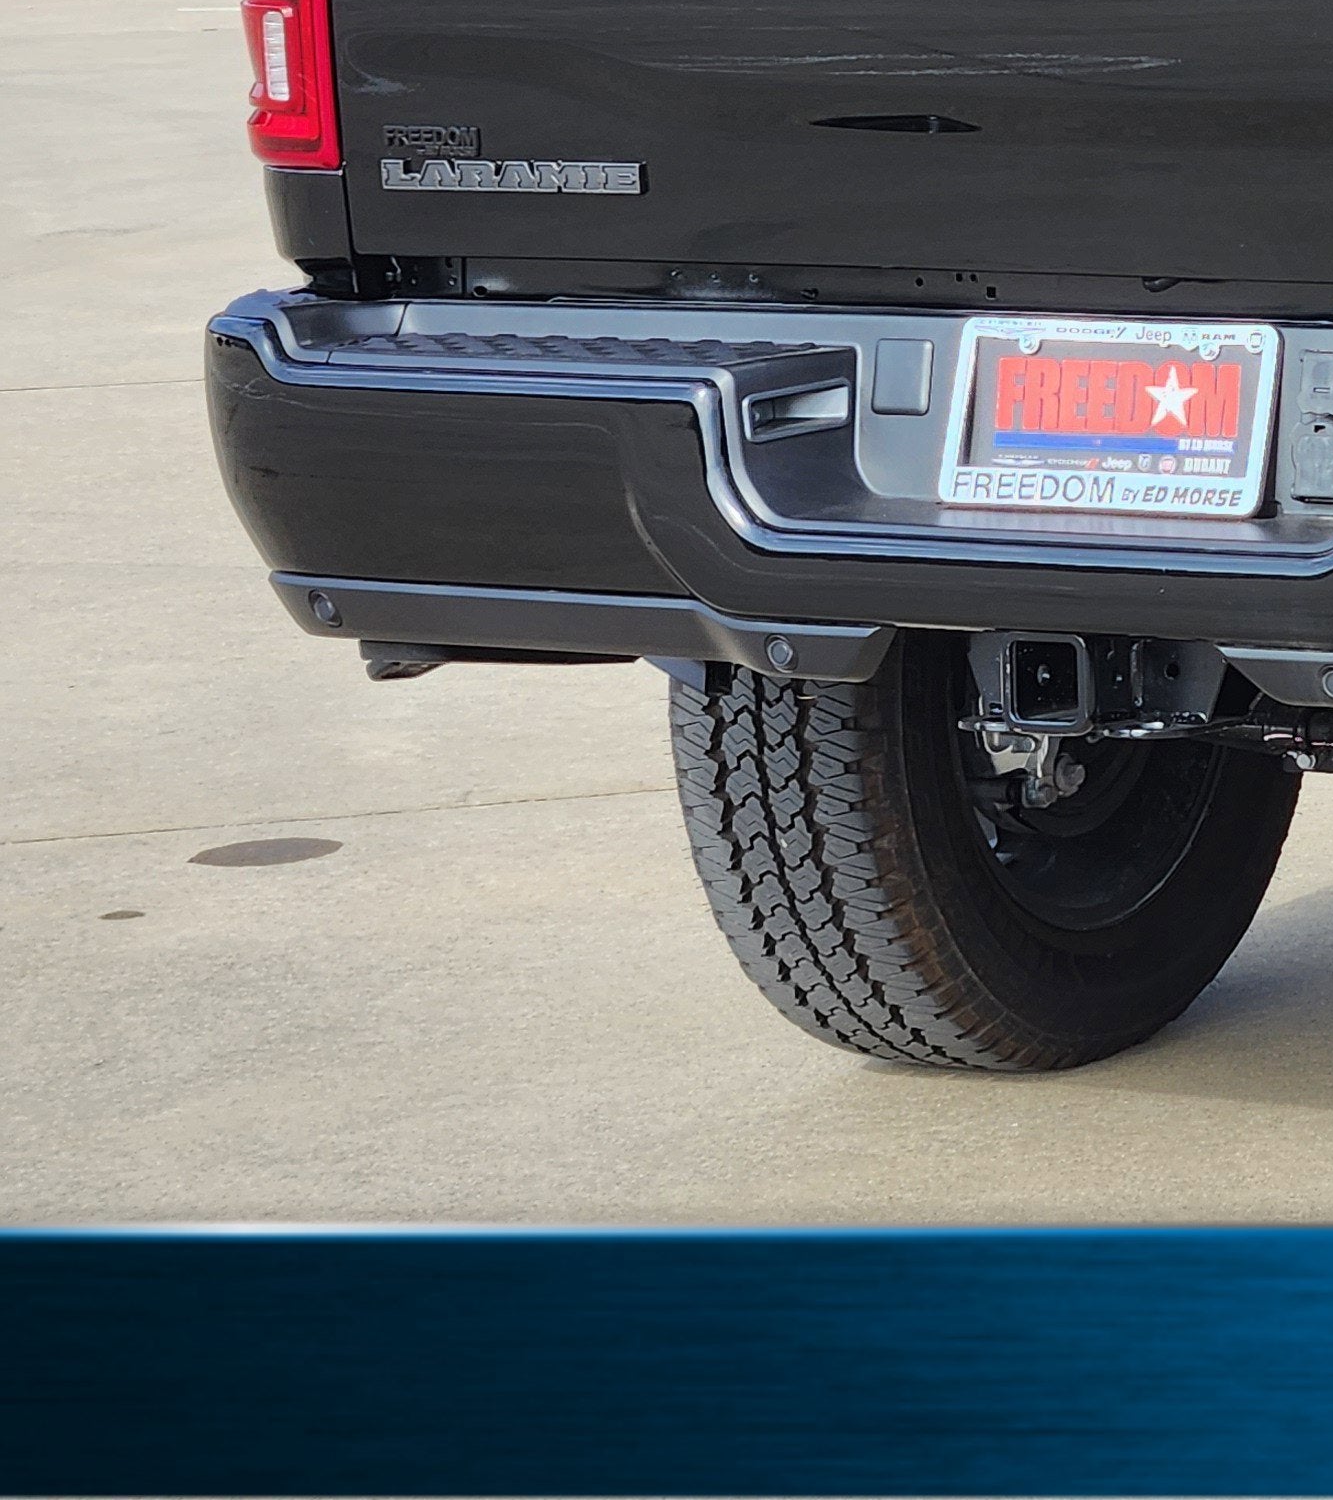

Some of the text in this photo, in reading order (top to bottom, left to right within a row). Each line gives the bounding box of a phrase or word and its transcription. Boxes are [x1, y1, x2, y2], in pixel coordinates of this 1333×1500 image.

[382, 125, 478, 146] FREEDOM
[381, 158, 642, 195] LARAMIE
[1135, 325, 1172, 343] Jeep
[994, 357, 1242, 437] FREEDOM
[1102, 456, 1132, 471] Jeep
[952, 471, 1116, 503] FREEDOM
[1142, 485, 1168, 503] ED
[1171, 486, 1243, 507] MORSE
